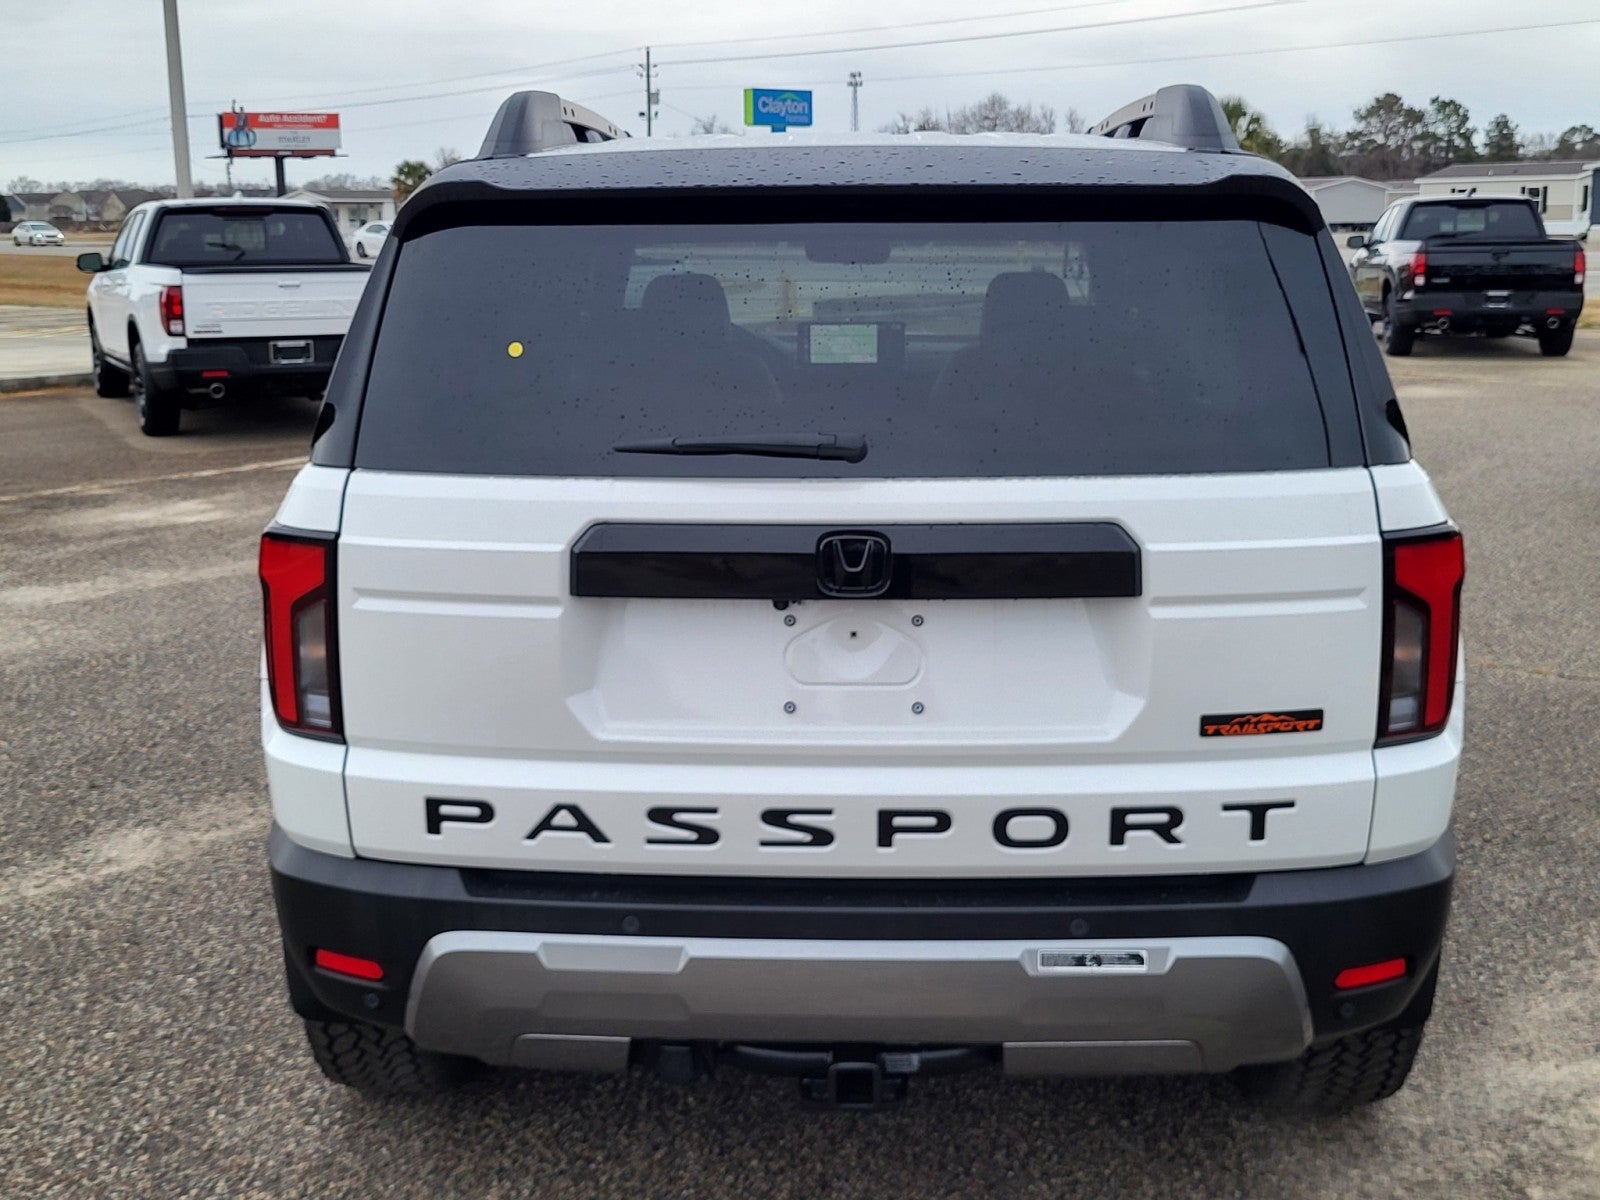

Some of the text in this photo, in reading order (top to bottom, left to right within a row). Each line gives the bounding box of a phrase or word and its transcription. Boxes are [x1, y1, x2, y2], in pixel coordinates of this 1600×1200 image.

[758, 96, 809, 117] Clayton
[1203, 719, 1321, 736] TRAILSPORT
[425, 797, 1296, 848] PASSPORT
